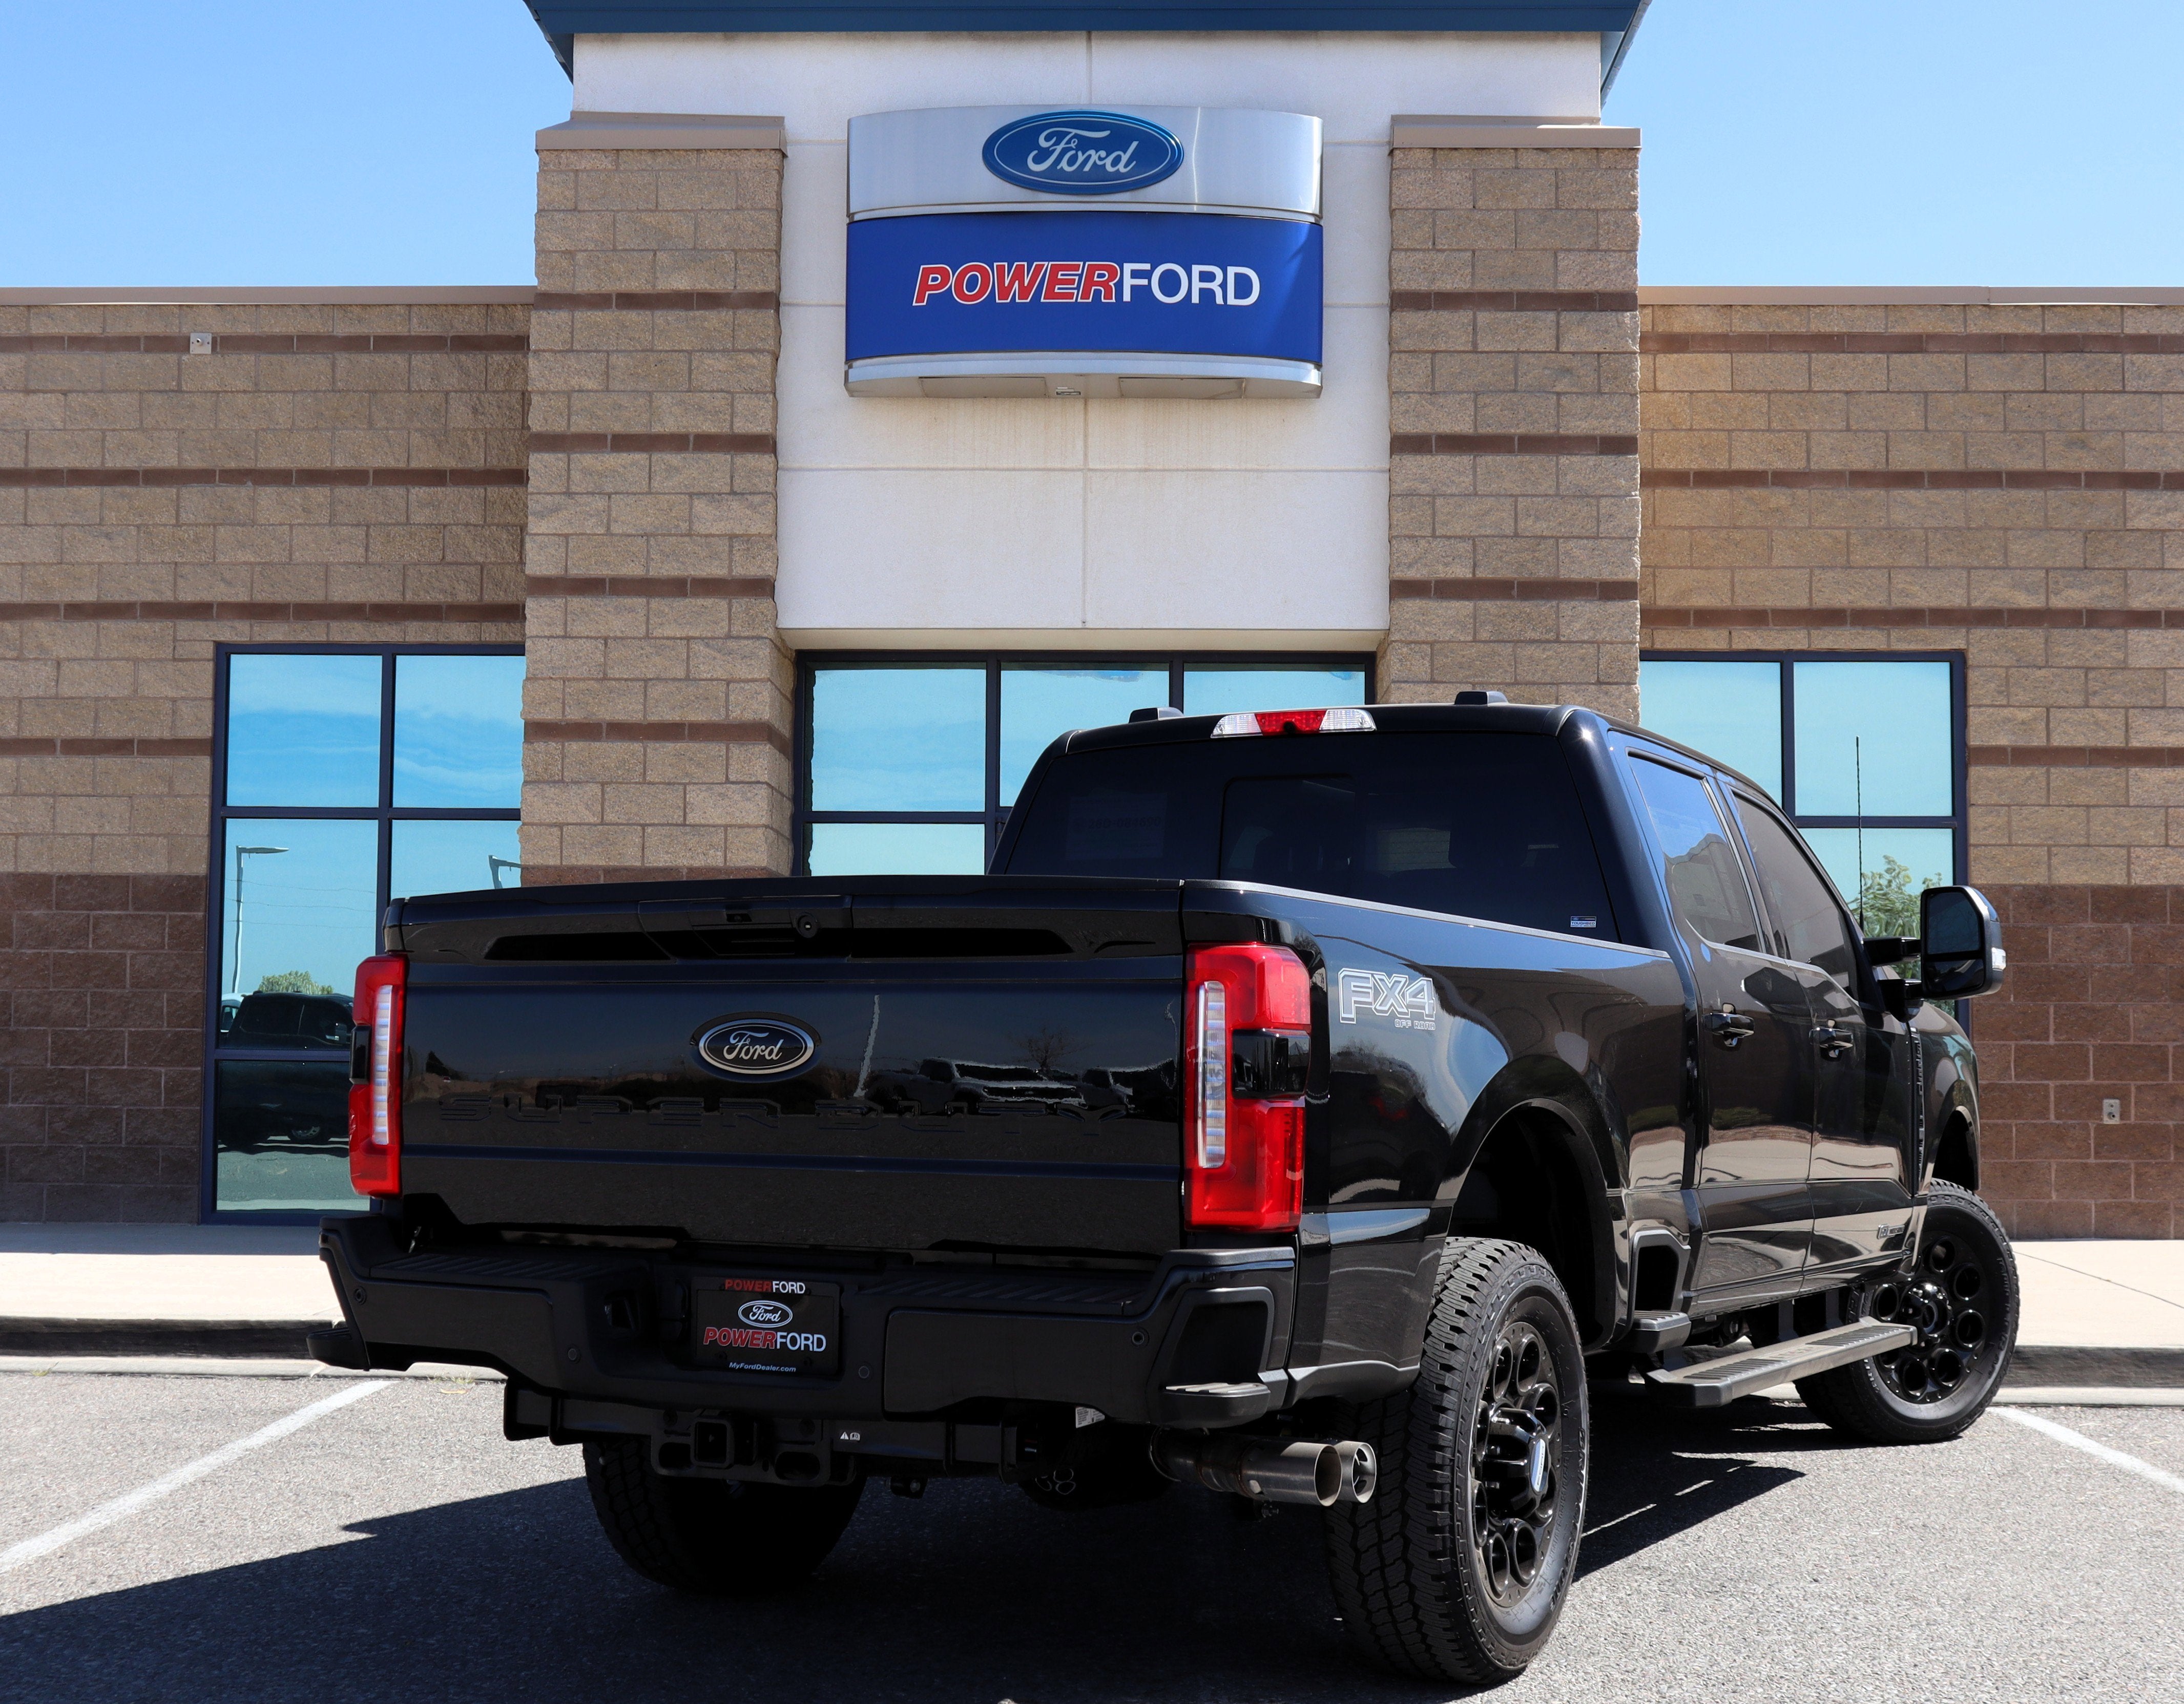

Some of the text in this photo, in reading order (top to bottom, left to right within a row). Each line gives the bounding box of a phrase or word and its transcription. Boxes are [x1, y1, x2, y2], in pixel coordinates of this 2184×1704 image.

[1027, 127, 1139, 173] Ford
[912, 262, 1260, 306] POWERFORD
[1338, 967, 1436, 1024] FX4
[1394, 1019, 1436, 1030] OFF ROAD
[723, 1030, 784, 1062] Ford
[439, 1092, 781, 1127] SUPER
[724, 1279, 806, 1294] POWERFORD
[749, 1305, 781, 1322] Ford
[703, 1327, 826, 1352] POWERFORD
[729, 1362, 796, 1372] MyFordDealer.com
